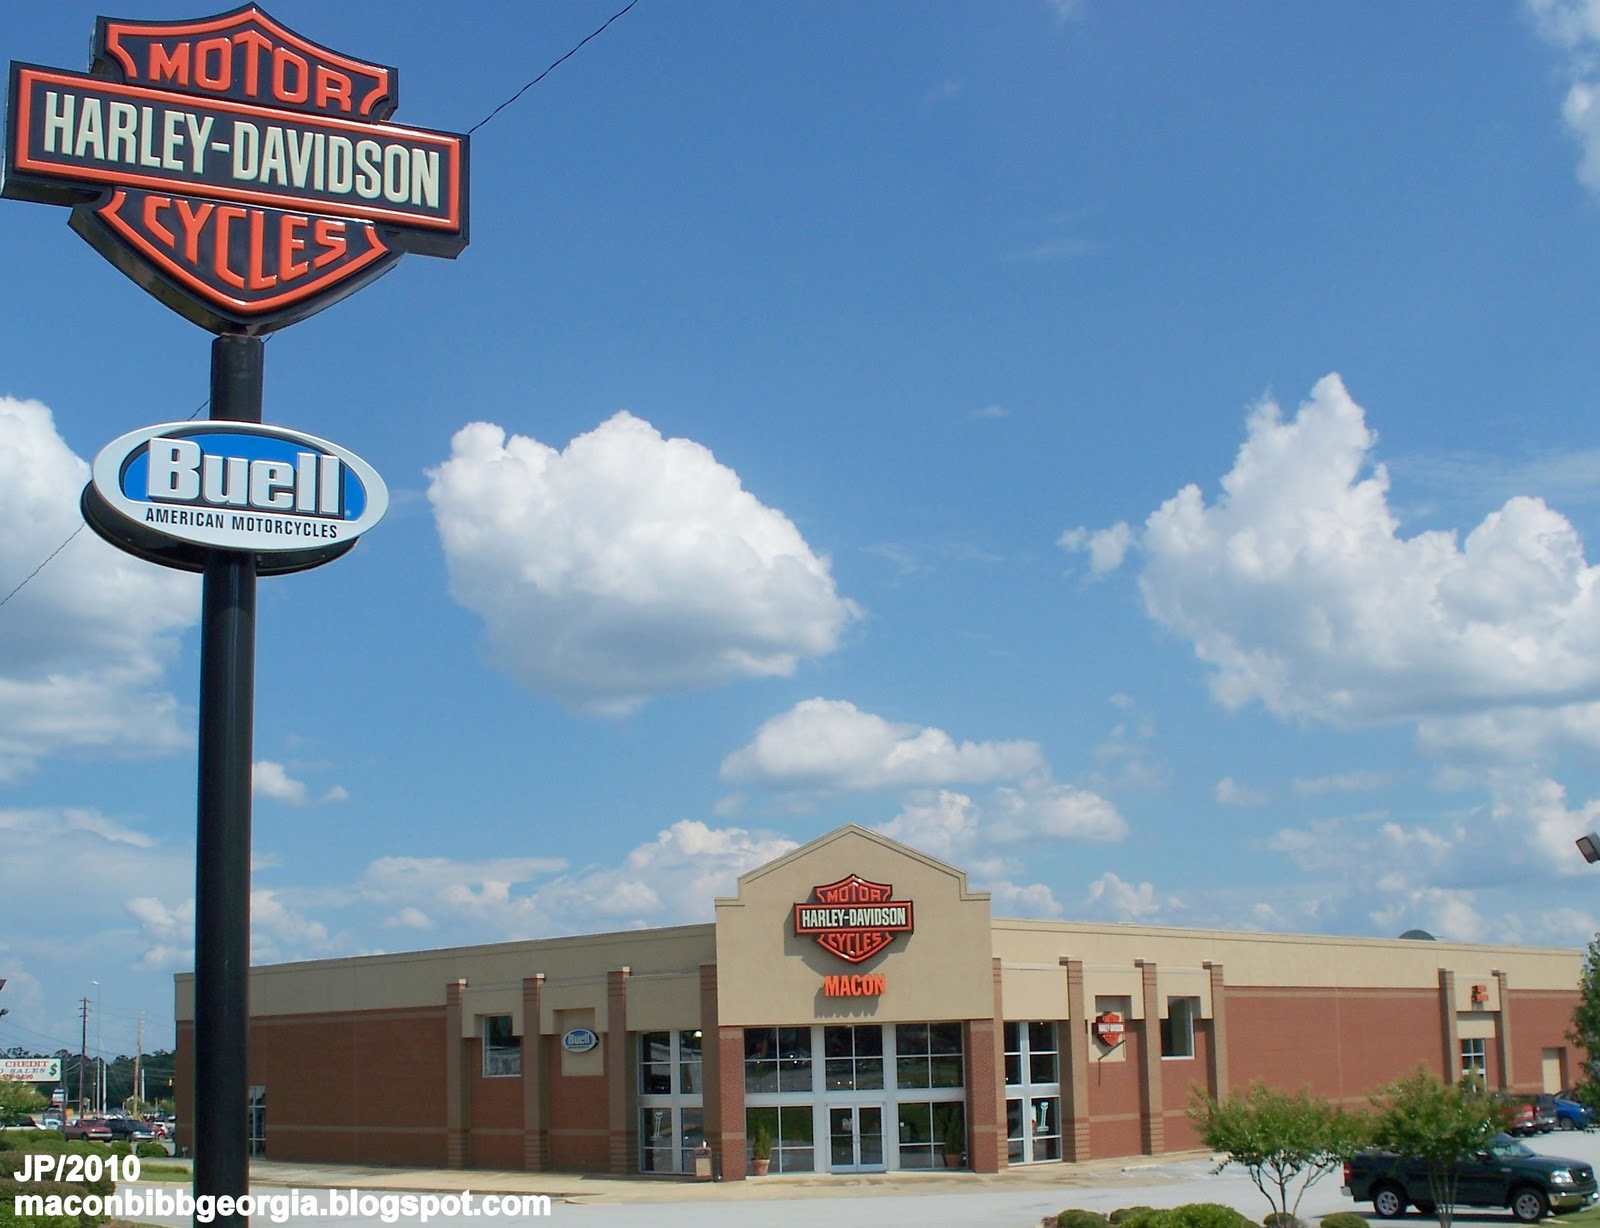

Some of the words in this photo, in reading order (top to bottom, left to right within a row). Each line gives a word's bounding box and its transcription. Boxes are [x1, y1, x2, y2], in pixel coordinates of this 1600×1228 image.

[149, 29, 352, 112] MOTOR
[43, 91, 440, 209] HARLEY-DAVIDSON
[143, 195, 347, 291] CYCLES
[147, 437, 341, 516] Buell
[145, 507, 225, 529] AMERICAN
[232, 515, 338, 539] MOTORCYCLES
[827, 881, 881, 903] MOTOR
[801, 907, 906, 928] HARLEY-DAVIDSON
[828, 932, 882, 956] CYCLES
[824, 973, 886, 997] MACON
